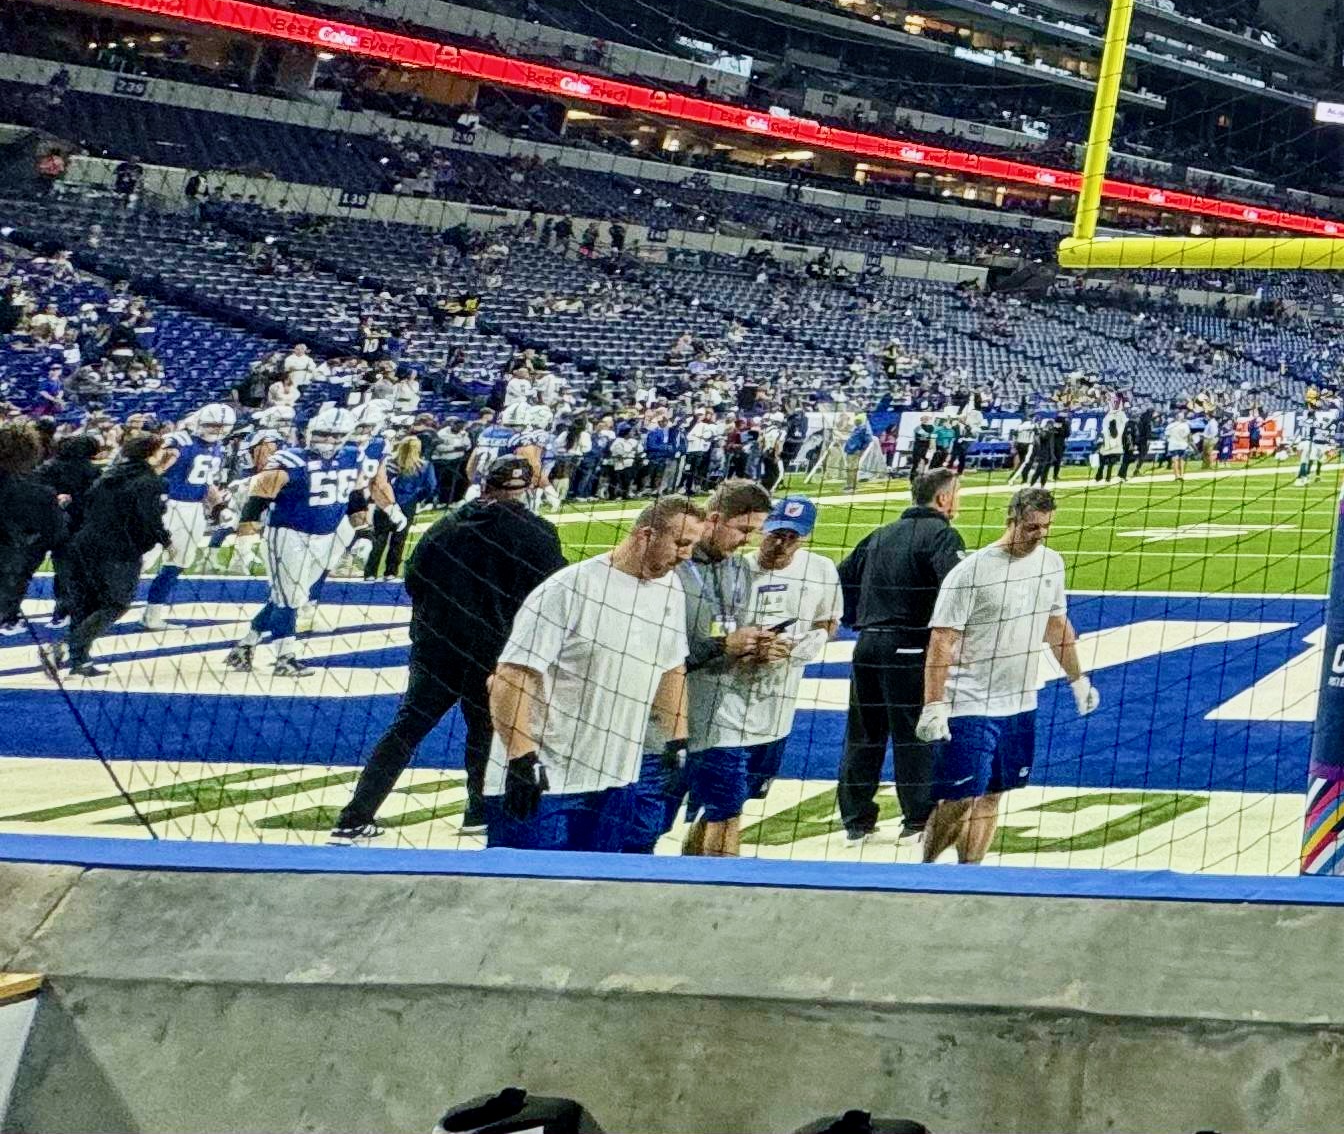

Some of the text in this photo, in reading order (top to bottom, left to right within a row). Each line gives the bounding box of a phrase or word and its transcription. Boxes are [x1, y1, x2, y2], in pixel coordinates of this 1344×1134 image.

[270, 17, 317, 40] Best
[318, 26, 359, 46] Coke
[560, 76, 592, 94] Coke
